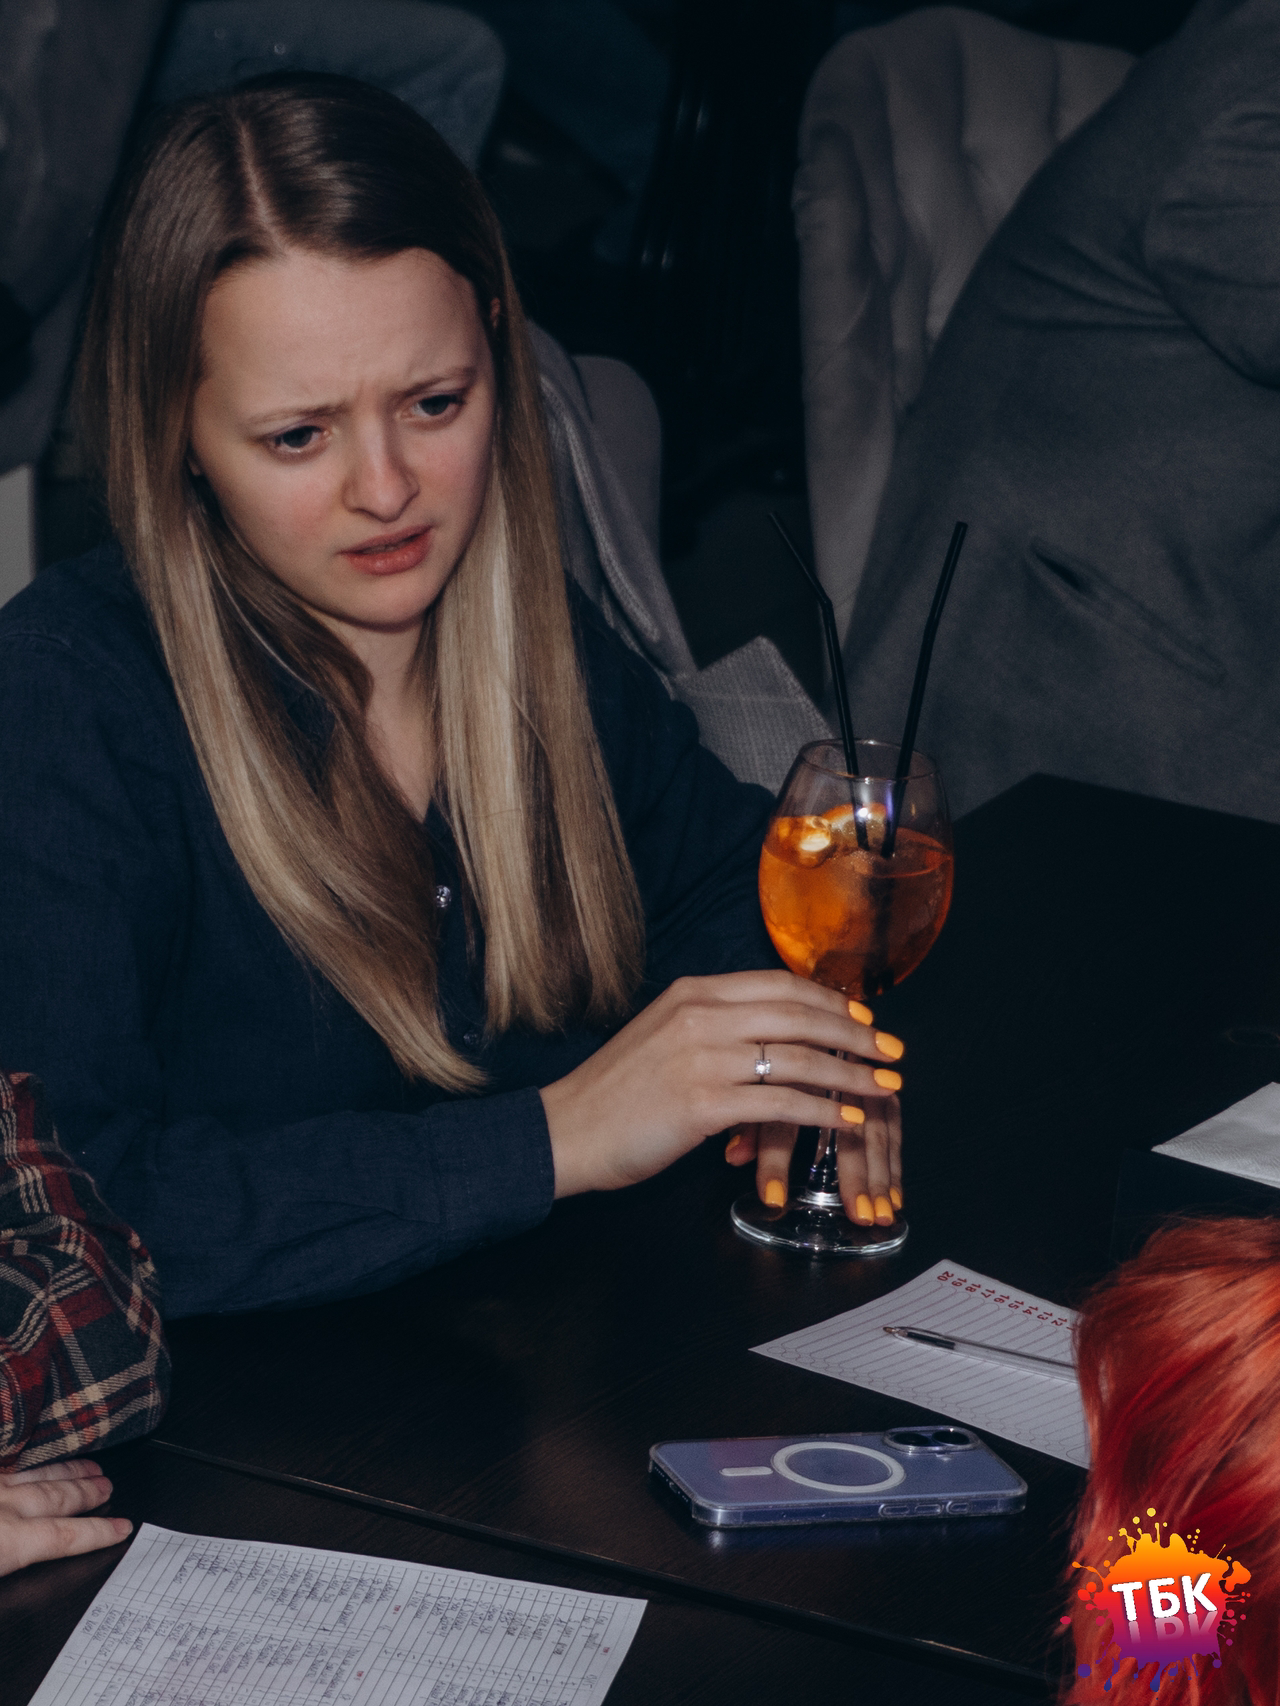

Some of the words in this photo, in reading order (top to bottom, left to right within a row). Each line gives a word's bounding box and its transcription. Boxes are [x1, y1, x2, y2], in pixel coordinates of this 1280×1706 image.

[937, 1271, 954, 1281] 20
[952, 1278, 967, 1286] 19
[965, 1284, 981, 1292] 18
[981, 1289, 995, 1298] 17
[994, 1294, 1010, 1303] 16
[1008, 1300, 1024, 1309] 15
[1022, 1306, 1038, 1315] 14
[1037, 1312, 1053, 1320] 13
[1051, 1318, 1067, 1326] 12
